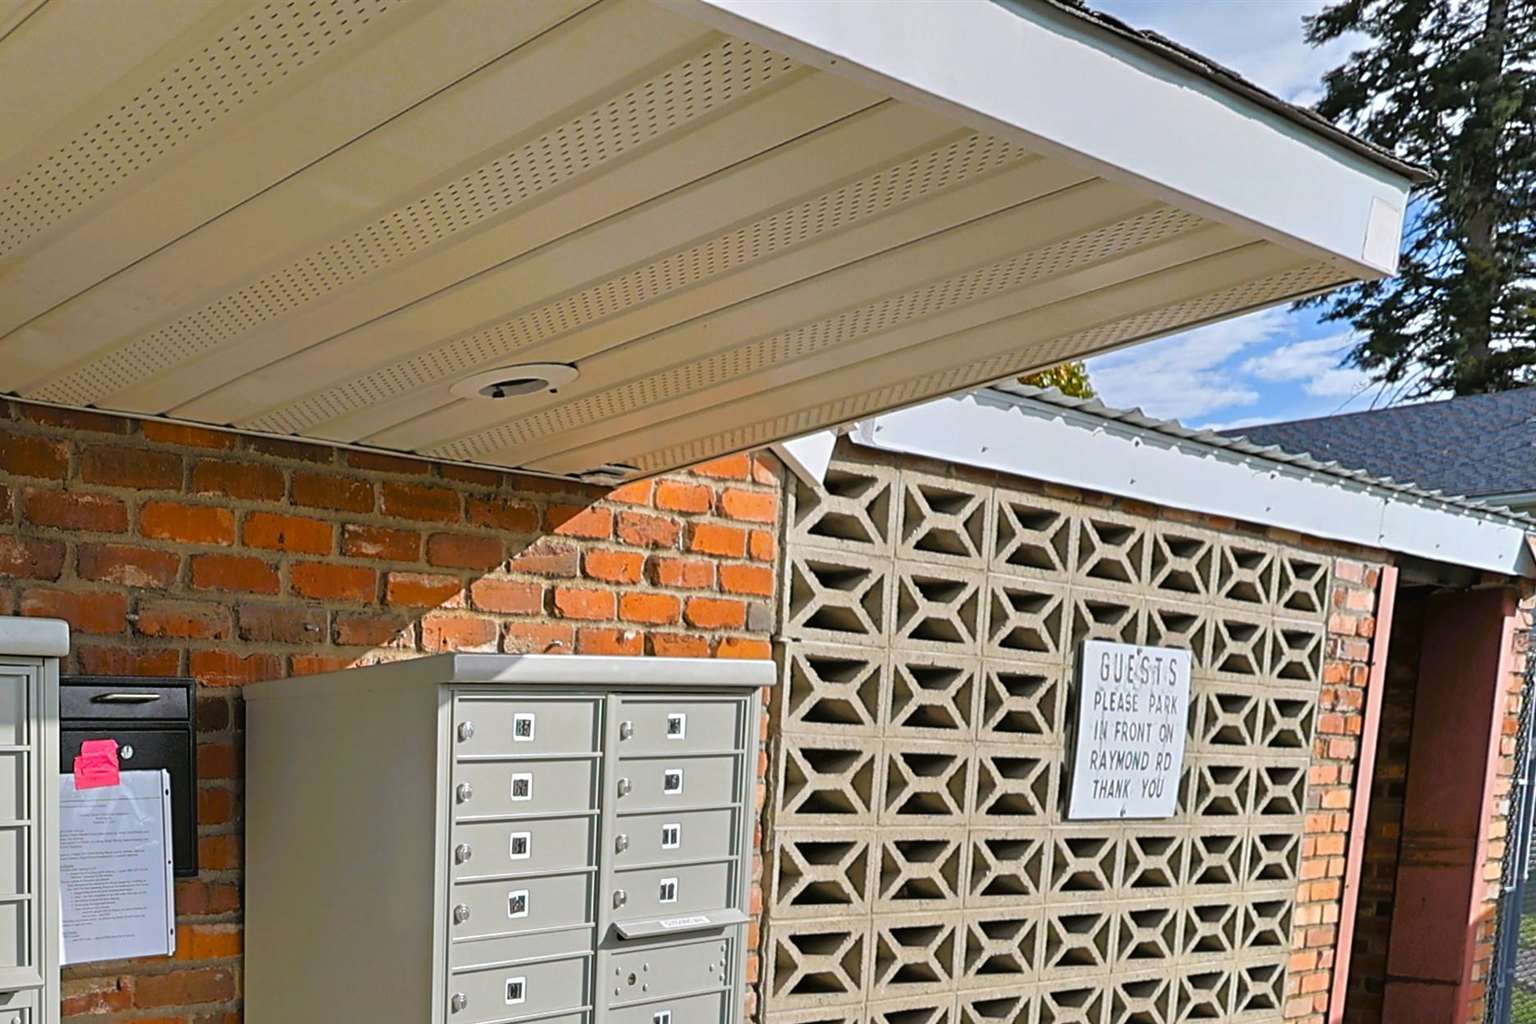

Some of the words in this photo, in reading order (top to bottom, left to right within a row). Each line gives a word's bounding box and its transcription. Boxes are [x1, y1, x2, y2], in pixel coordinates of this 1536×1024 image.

[1100, 652, 1177, 686] GUESTS
[1094, 691, 1138, 712] PLEASE
[1148, 692, 1178, 714] PARK
[1093, 720, 1107, 741] IN
[1115, 721, 1152, 743] FRONT
[1159, 723, 1174, 744] ON
[1090, 750, 1150, 771] RAYMOND
[1155, 752, 1172, 771] RD
[1093, 779, 1131, 799] THANK
[1142, 778, 1164, 798] YOU
